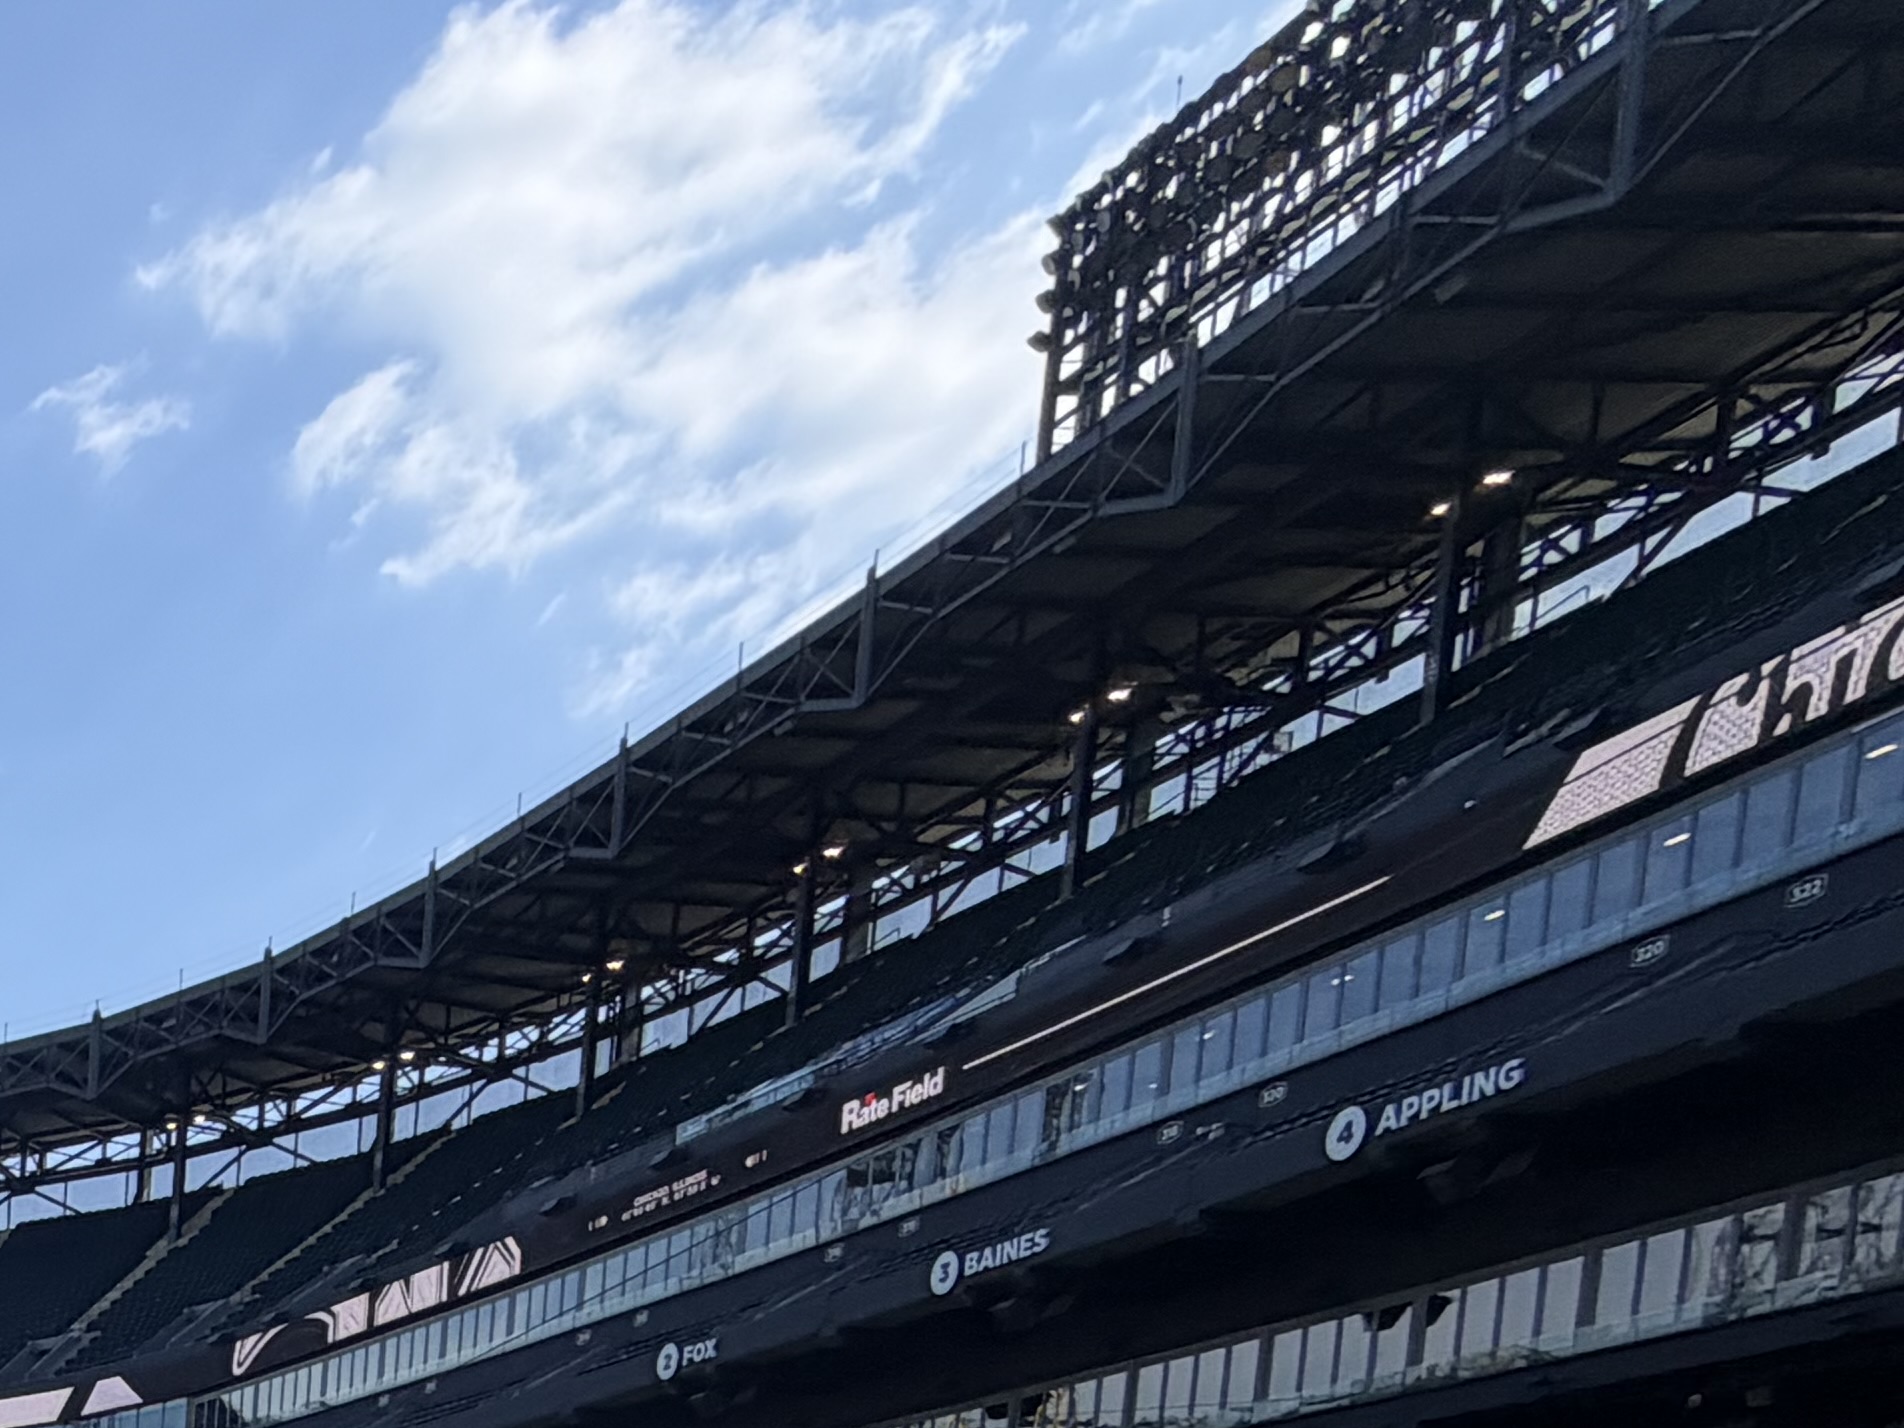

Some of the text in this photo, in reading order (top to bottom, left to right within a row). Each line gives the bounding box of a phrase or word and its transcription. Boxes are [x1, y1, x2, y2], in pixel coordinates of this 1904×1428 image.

[840, 1066, 945, 1135] Rate Field
[1375, 1058, 1527, 1137] APPLING
[963, 1228, 1051, 1277] BAINES
[682, 1338, 718, 1367] FOX
